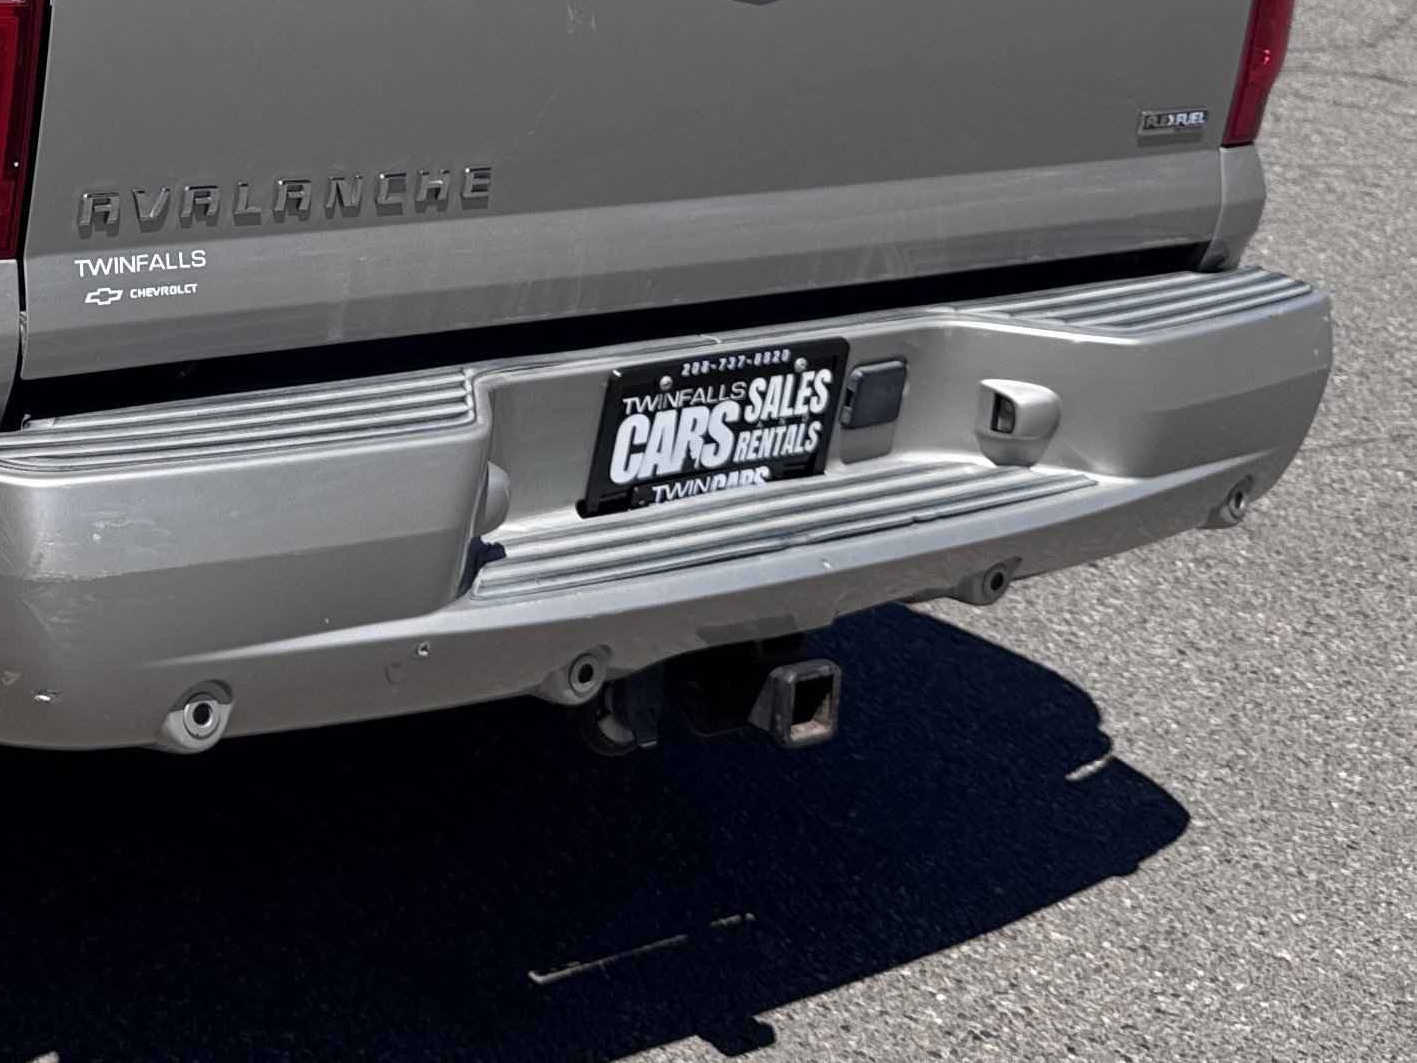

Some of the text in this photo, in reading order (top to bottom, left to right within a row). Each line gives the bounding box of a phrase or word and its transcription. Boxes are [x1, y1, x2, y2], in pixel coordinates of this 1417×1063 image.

[77, 165, 493, 229] AVALANCHE
[74, 249, 207, 278] TWINFALLS
[129, 282, 198, 299] CHEVROLET
[622, 381, 748, 416] TWINFALLS
[744, 368, 834, 424] SALES
[609, 400, 743, 486] CARS
[733, 420, 823, 463] RENTALS
